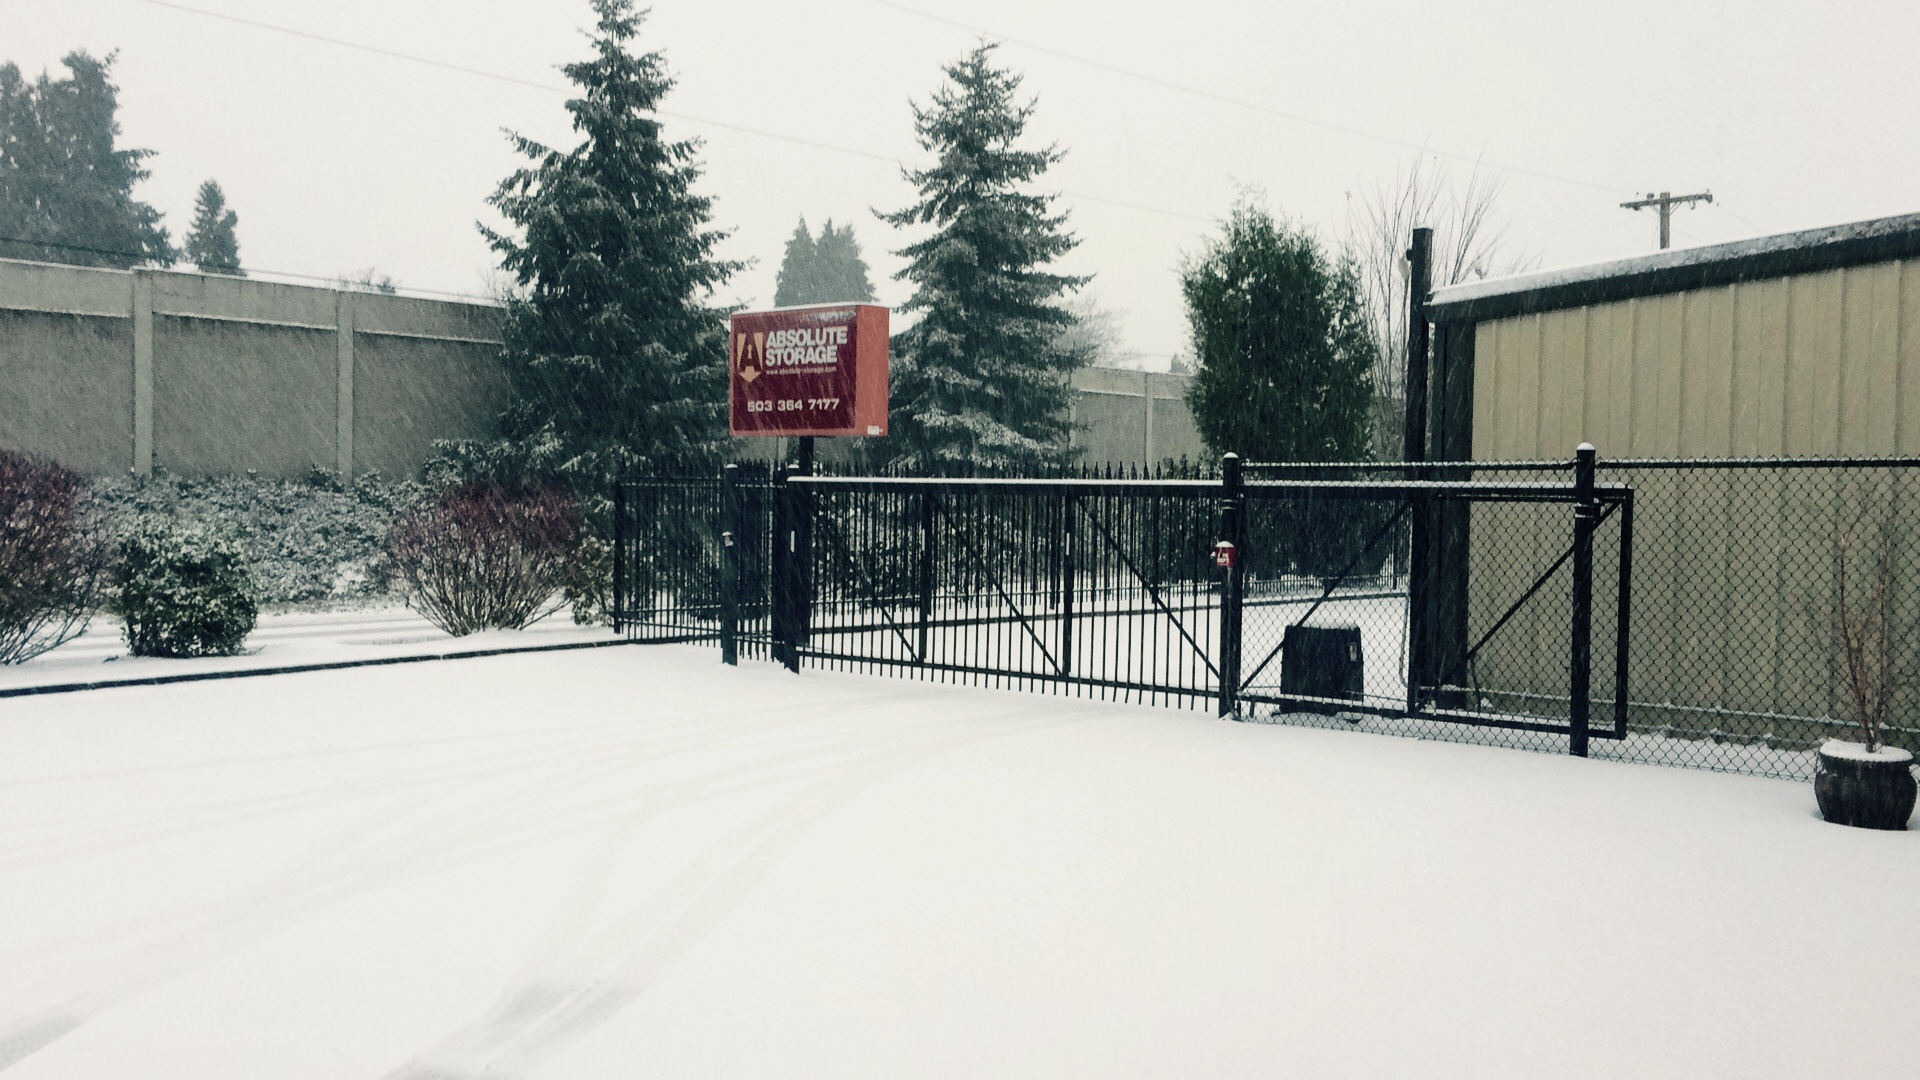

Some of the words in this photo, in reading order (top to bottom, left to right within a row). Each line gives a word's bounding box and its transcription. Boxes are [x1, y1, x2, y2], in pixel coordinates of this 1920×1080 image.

[766, 326, 848, 349] ABSOLUTE
[766, 345, 838, 367] STORAGE
[747, 400, 773, 412] 503
[777, 399, 803, 411] 364
[808, 398, 840, 411] 7177
